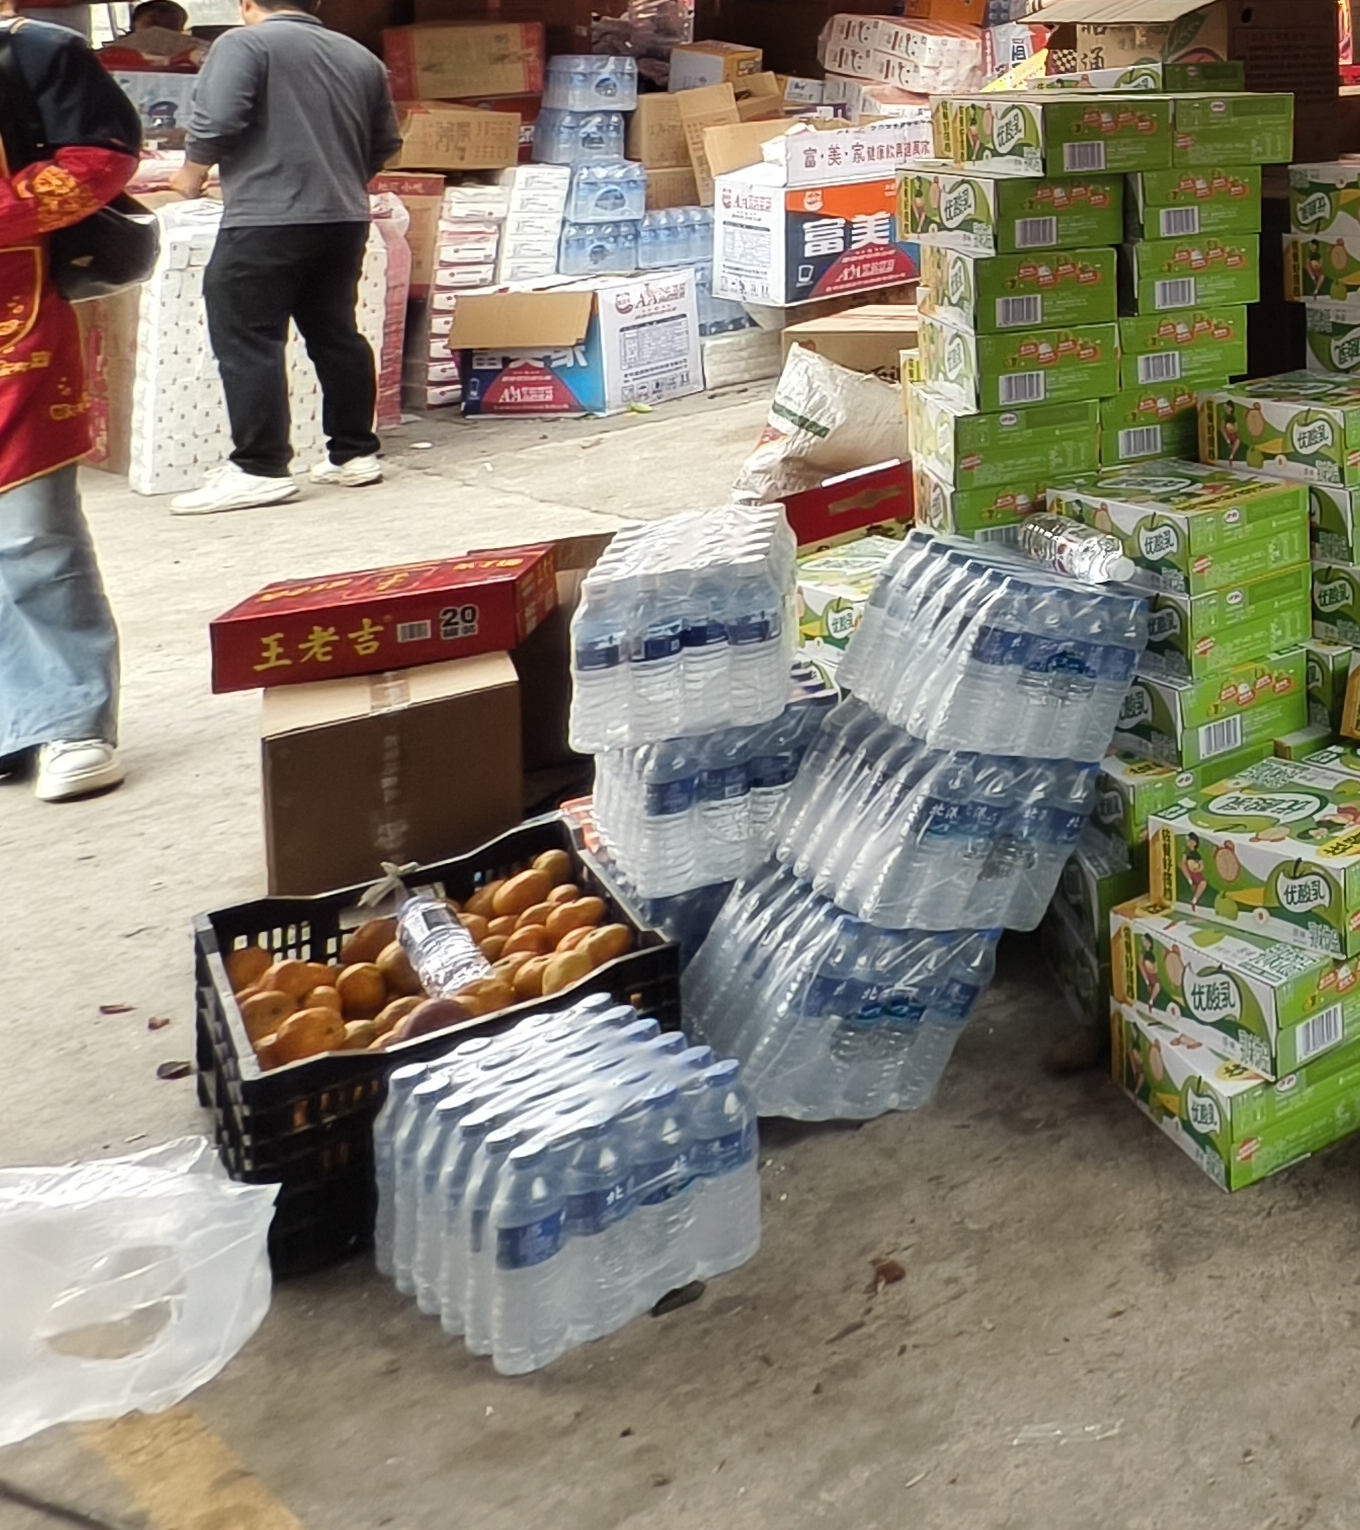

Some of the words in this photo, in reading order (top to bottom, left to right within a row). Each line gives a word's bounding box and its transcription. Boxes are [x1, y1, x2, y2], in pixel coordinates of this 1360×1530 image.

[441, 606, 477, 626] 20
[253, 618, 384, 672] 王老吉
[1283, 880, 1326, 904] 优酸乳
[1190, 981, 1236, 1013] 优酸乳
